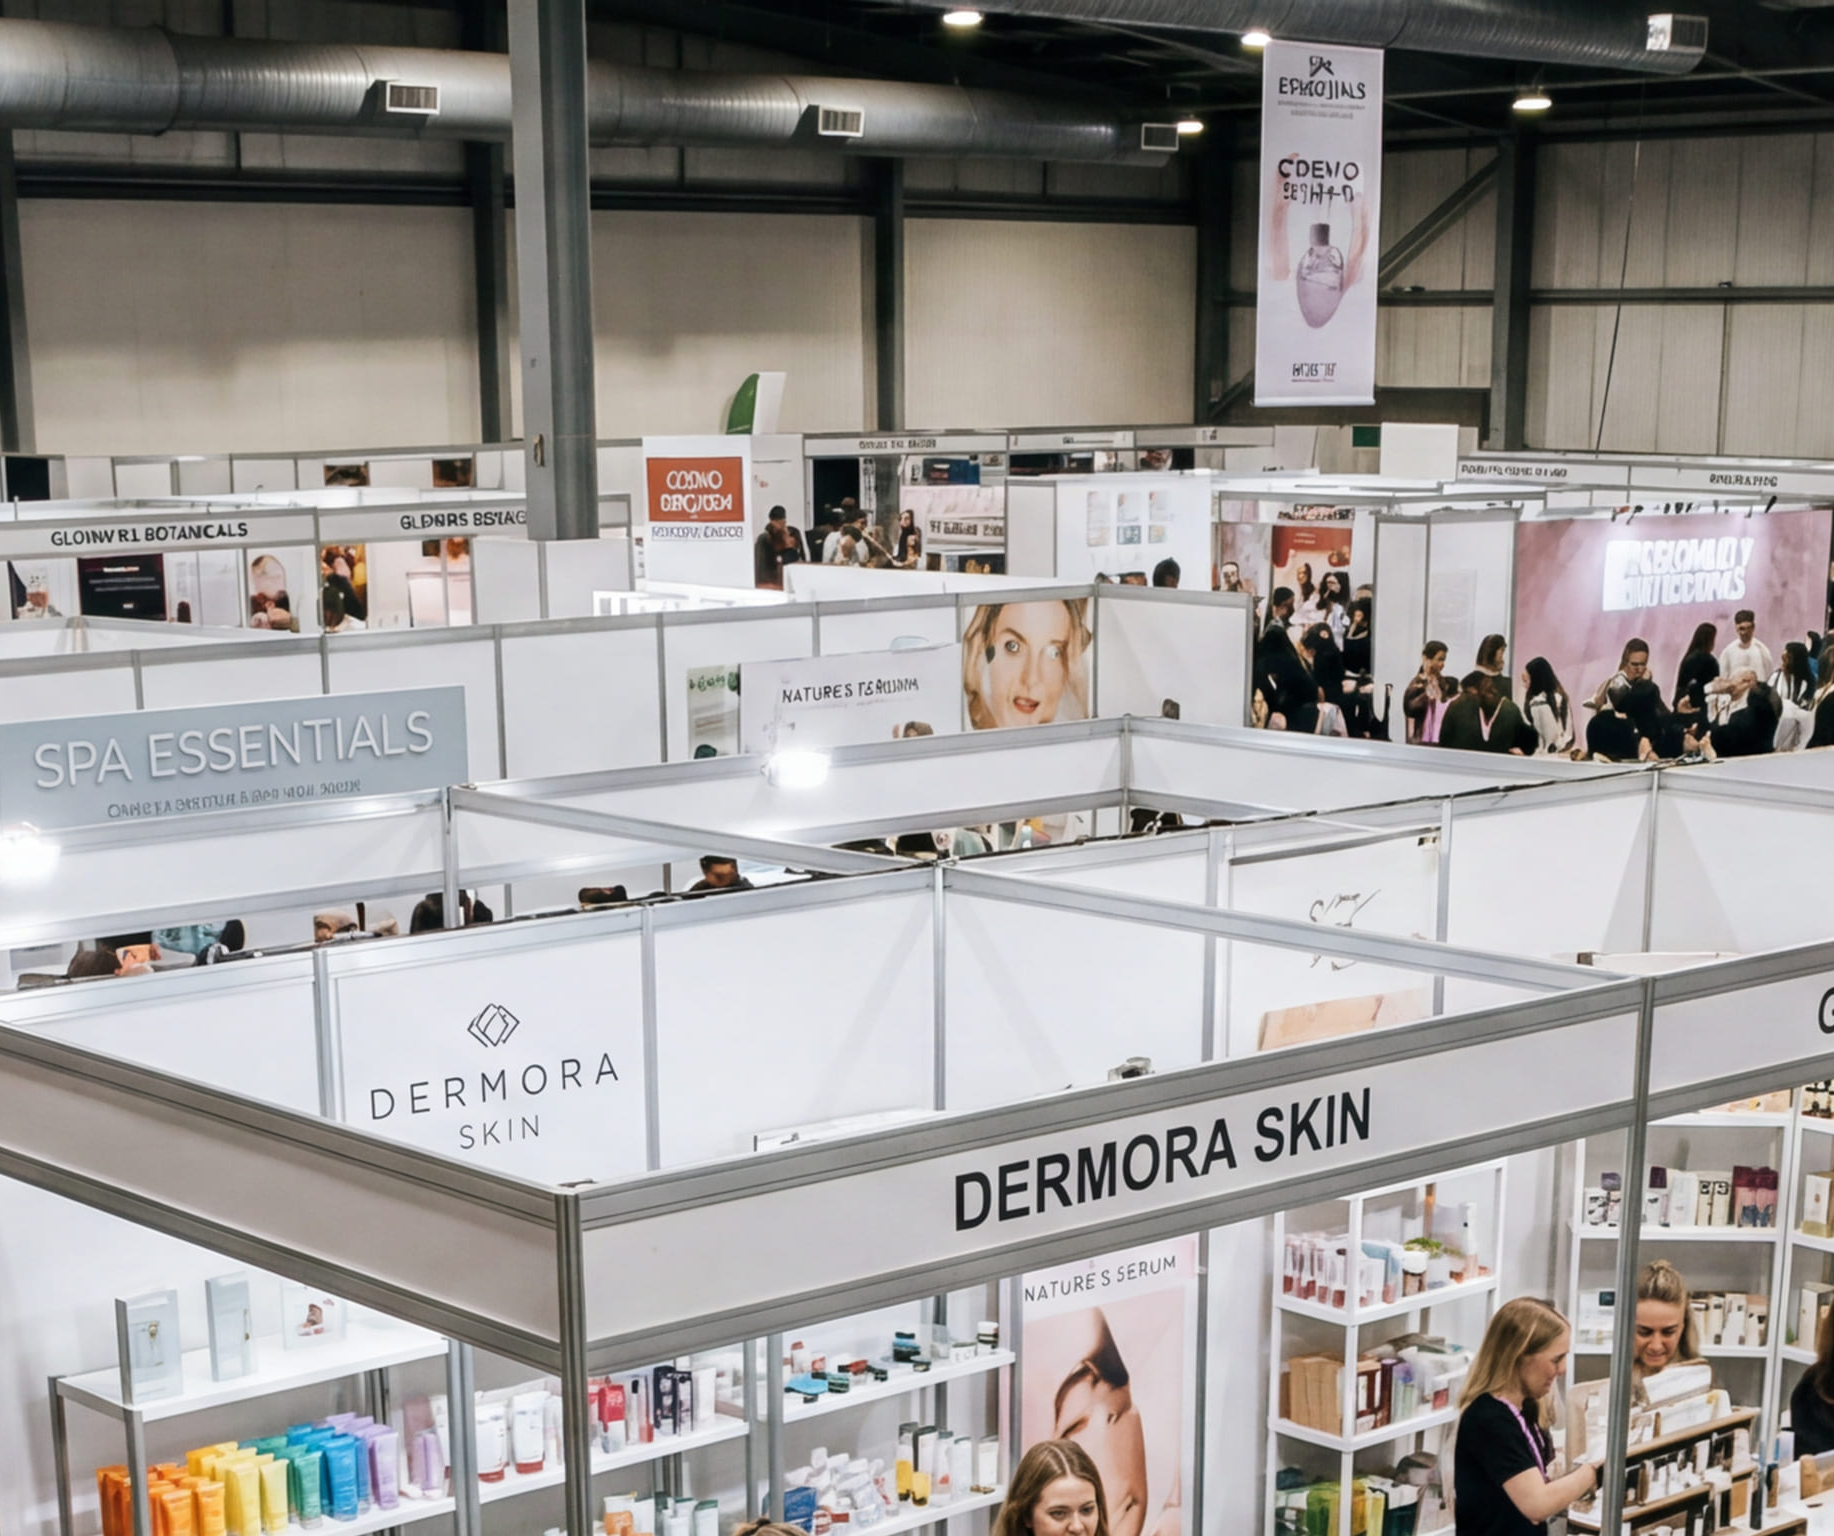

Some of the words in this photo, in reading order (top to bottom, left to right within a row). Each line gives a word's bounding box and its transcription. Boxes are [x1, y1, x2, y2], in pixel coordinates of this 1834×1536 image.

[33, 736, 134, 791] SPA
[148, 709, 434, 780] ESSENTIALS
[368, 1050, 621, 1123] DERMORA
[458, 1112, 542, 1149] SKIN
[955, 1117, 1240, 1232] DERMORA
[1253, 1085, 1373, 1164] SKIN
[1116, 1255, 1177, 1283] SERUM
